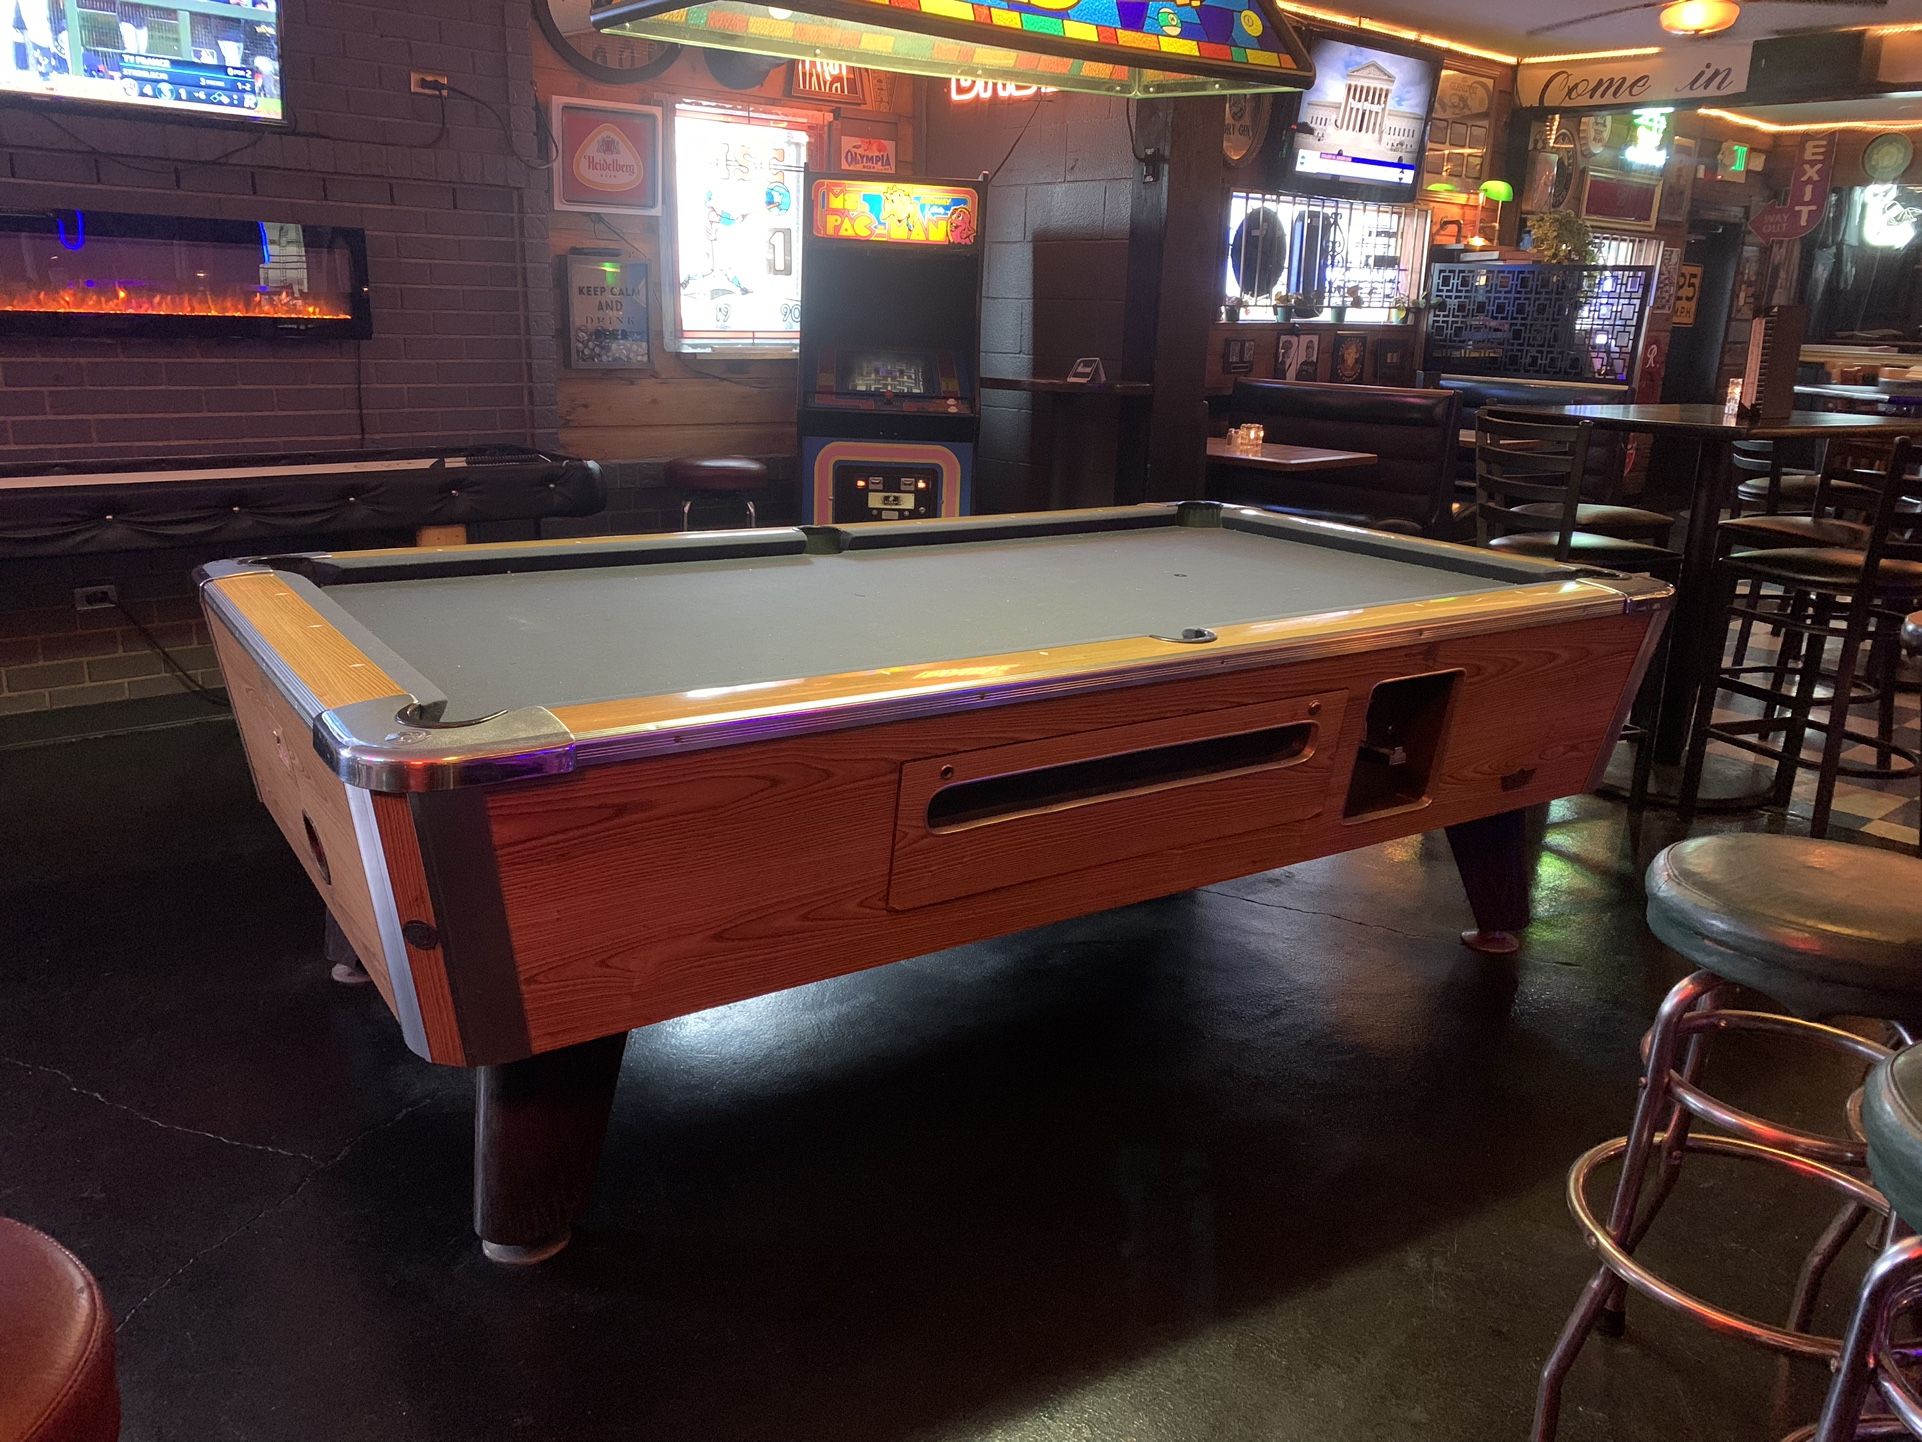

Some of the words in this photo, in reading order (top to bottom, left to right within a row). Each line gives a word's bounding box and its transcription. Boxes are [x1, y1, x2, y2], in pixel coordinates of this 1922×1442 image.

[1538, 69, 1651, 105] Come
[1674, 62, 1734, 93] in
[584, 155, 635, 176] Heidelberg
[844, 149, 892, 169] OLYMPIA
[1794, 140, 1828, 226] EXIT
[826, 214, 949, 242] PAC-MAN
[1762, 223, 1788, 233] OUT
[1764, 213, 1790, 223] WAY
[578, 286, 606, 296] KEEP
[610, 287, 641, 297] CALM
[1676, 272, 1698, 302] 25
[597, 300, 623, 311] AND
[715, 303, 731, 323] 19
[780, 303, 802, 324] 90
[585, 315, 634, 325] DRINK
